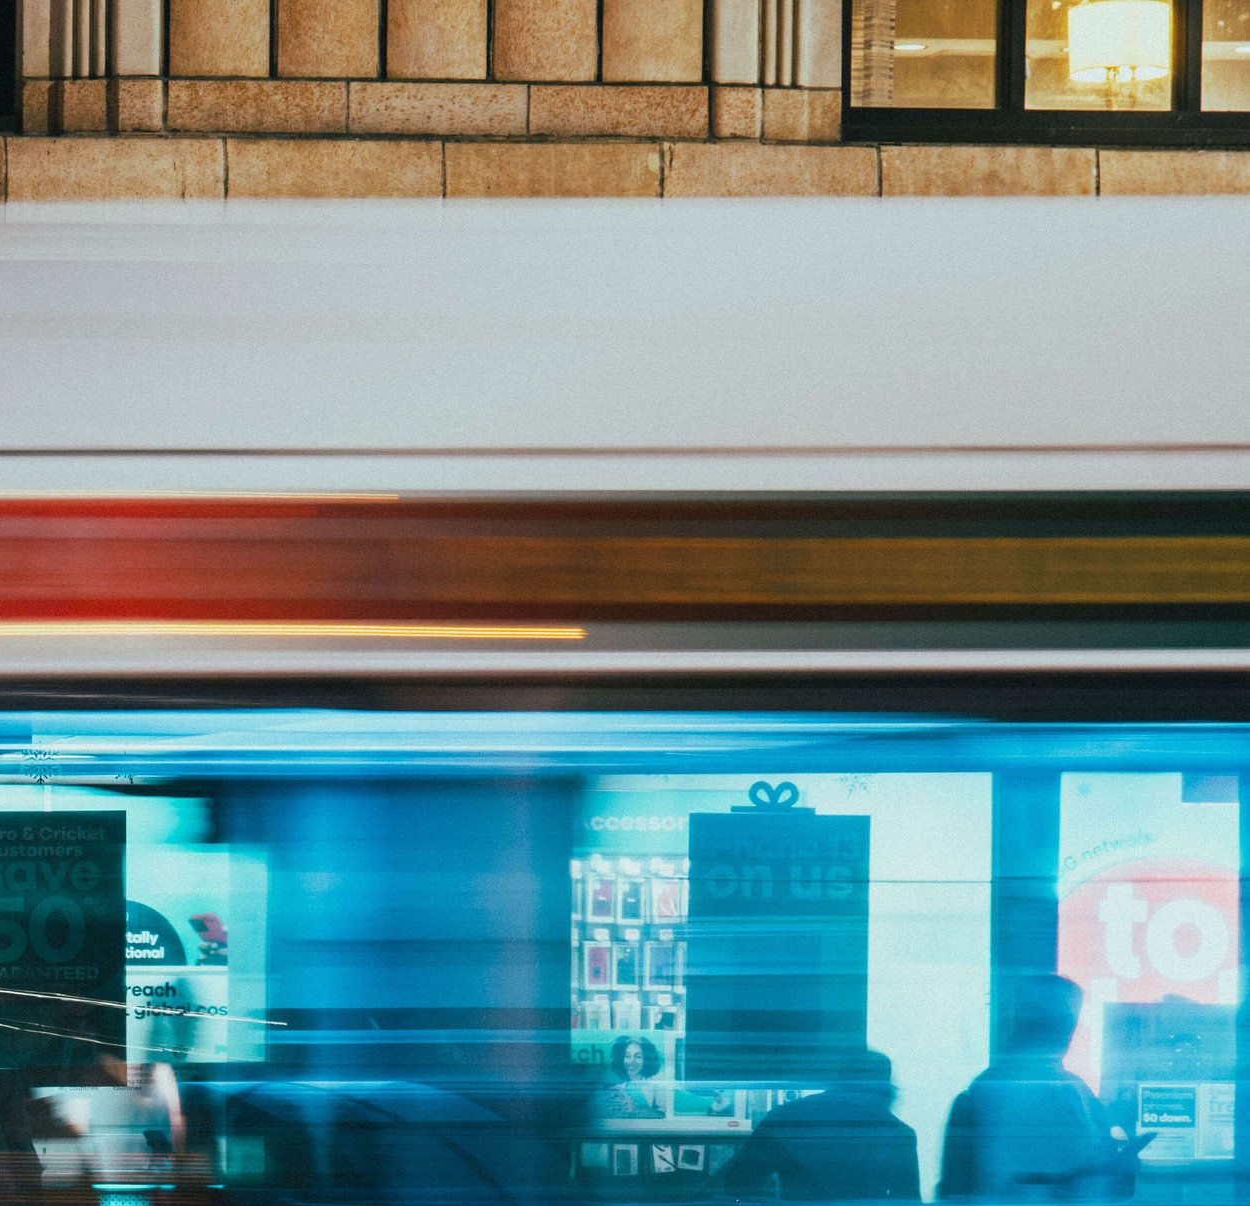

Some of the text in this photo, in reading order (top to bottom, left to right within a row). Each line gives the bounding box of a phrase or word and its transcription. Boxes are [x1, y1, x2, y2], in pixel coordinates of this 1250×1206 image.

[22, 826, 34, 841] &
[705, 864, 853, 899] on us
[1097, 882, 1231, 982] to
